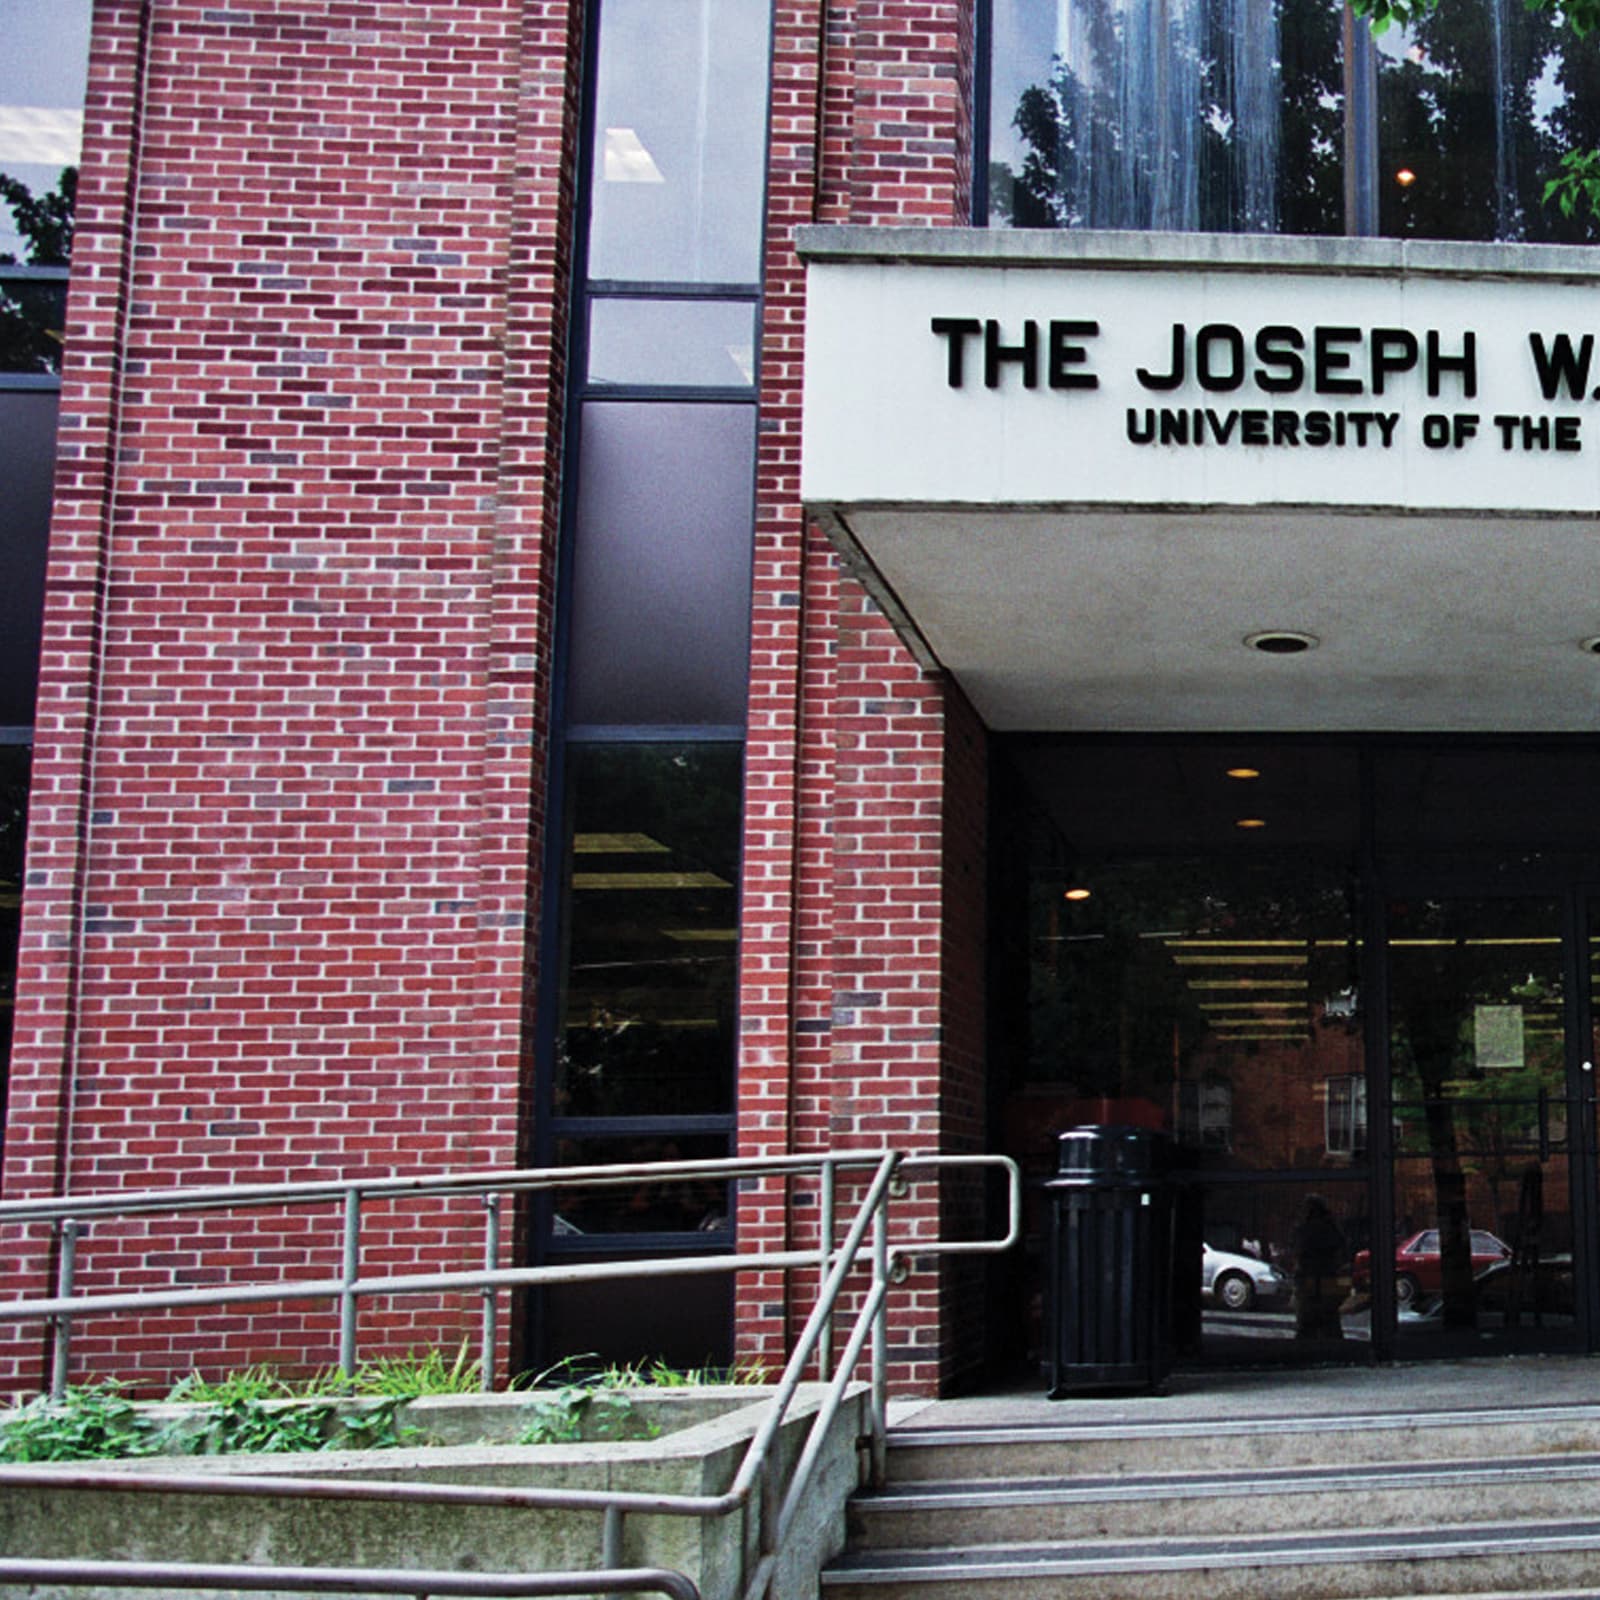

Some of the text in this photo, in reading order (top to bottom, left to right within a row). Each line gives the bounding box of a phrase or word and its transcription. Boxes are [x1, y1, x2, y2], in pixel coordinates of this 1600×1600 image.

[931, 317, 1099, 390] THE
[1136, 322, 1477, 399] JOSEPH
[1126, 407, 1400, 447] UNIVERSITY
[1422, 413, 1480, 449] OF
[1495, 415, 1582, 452] THE
